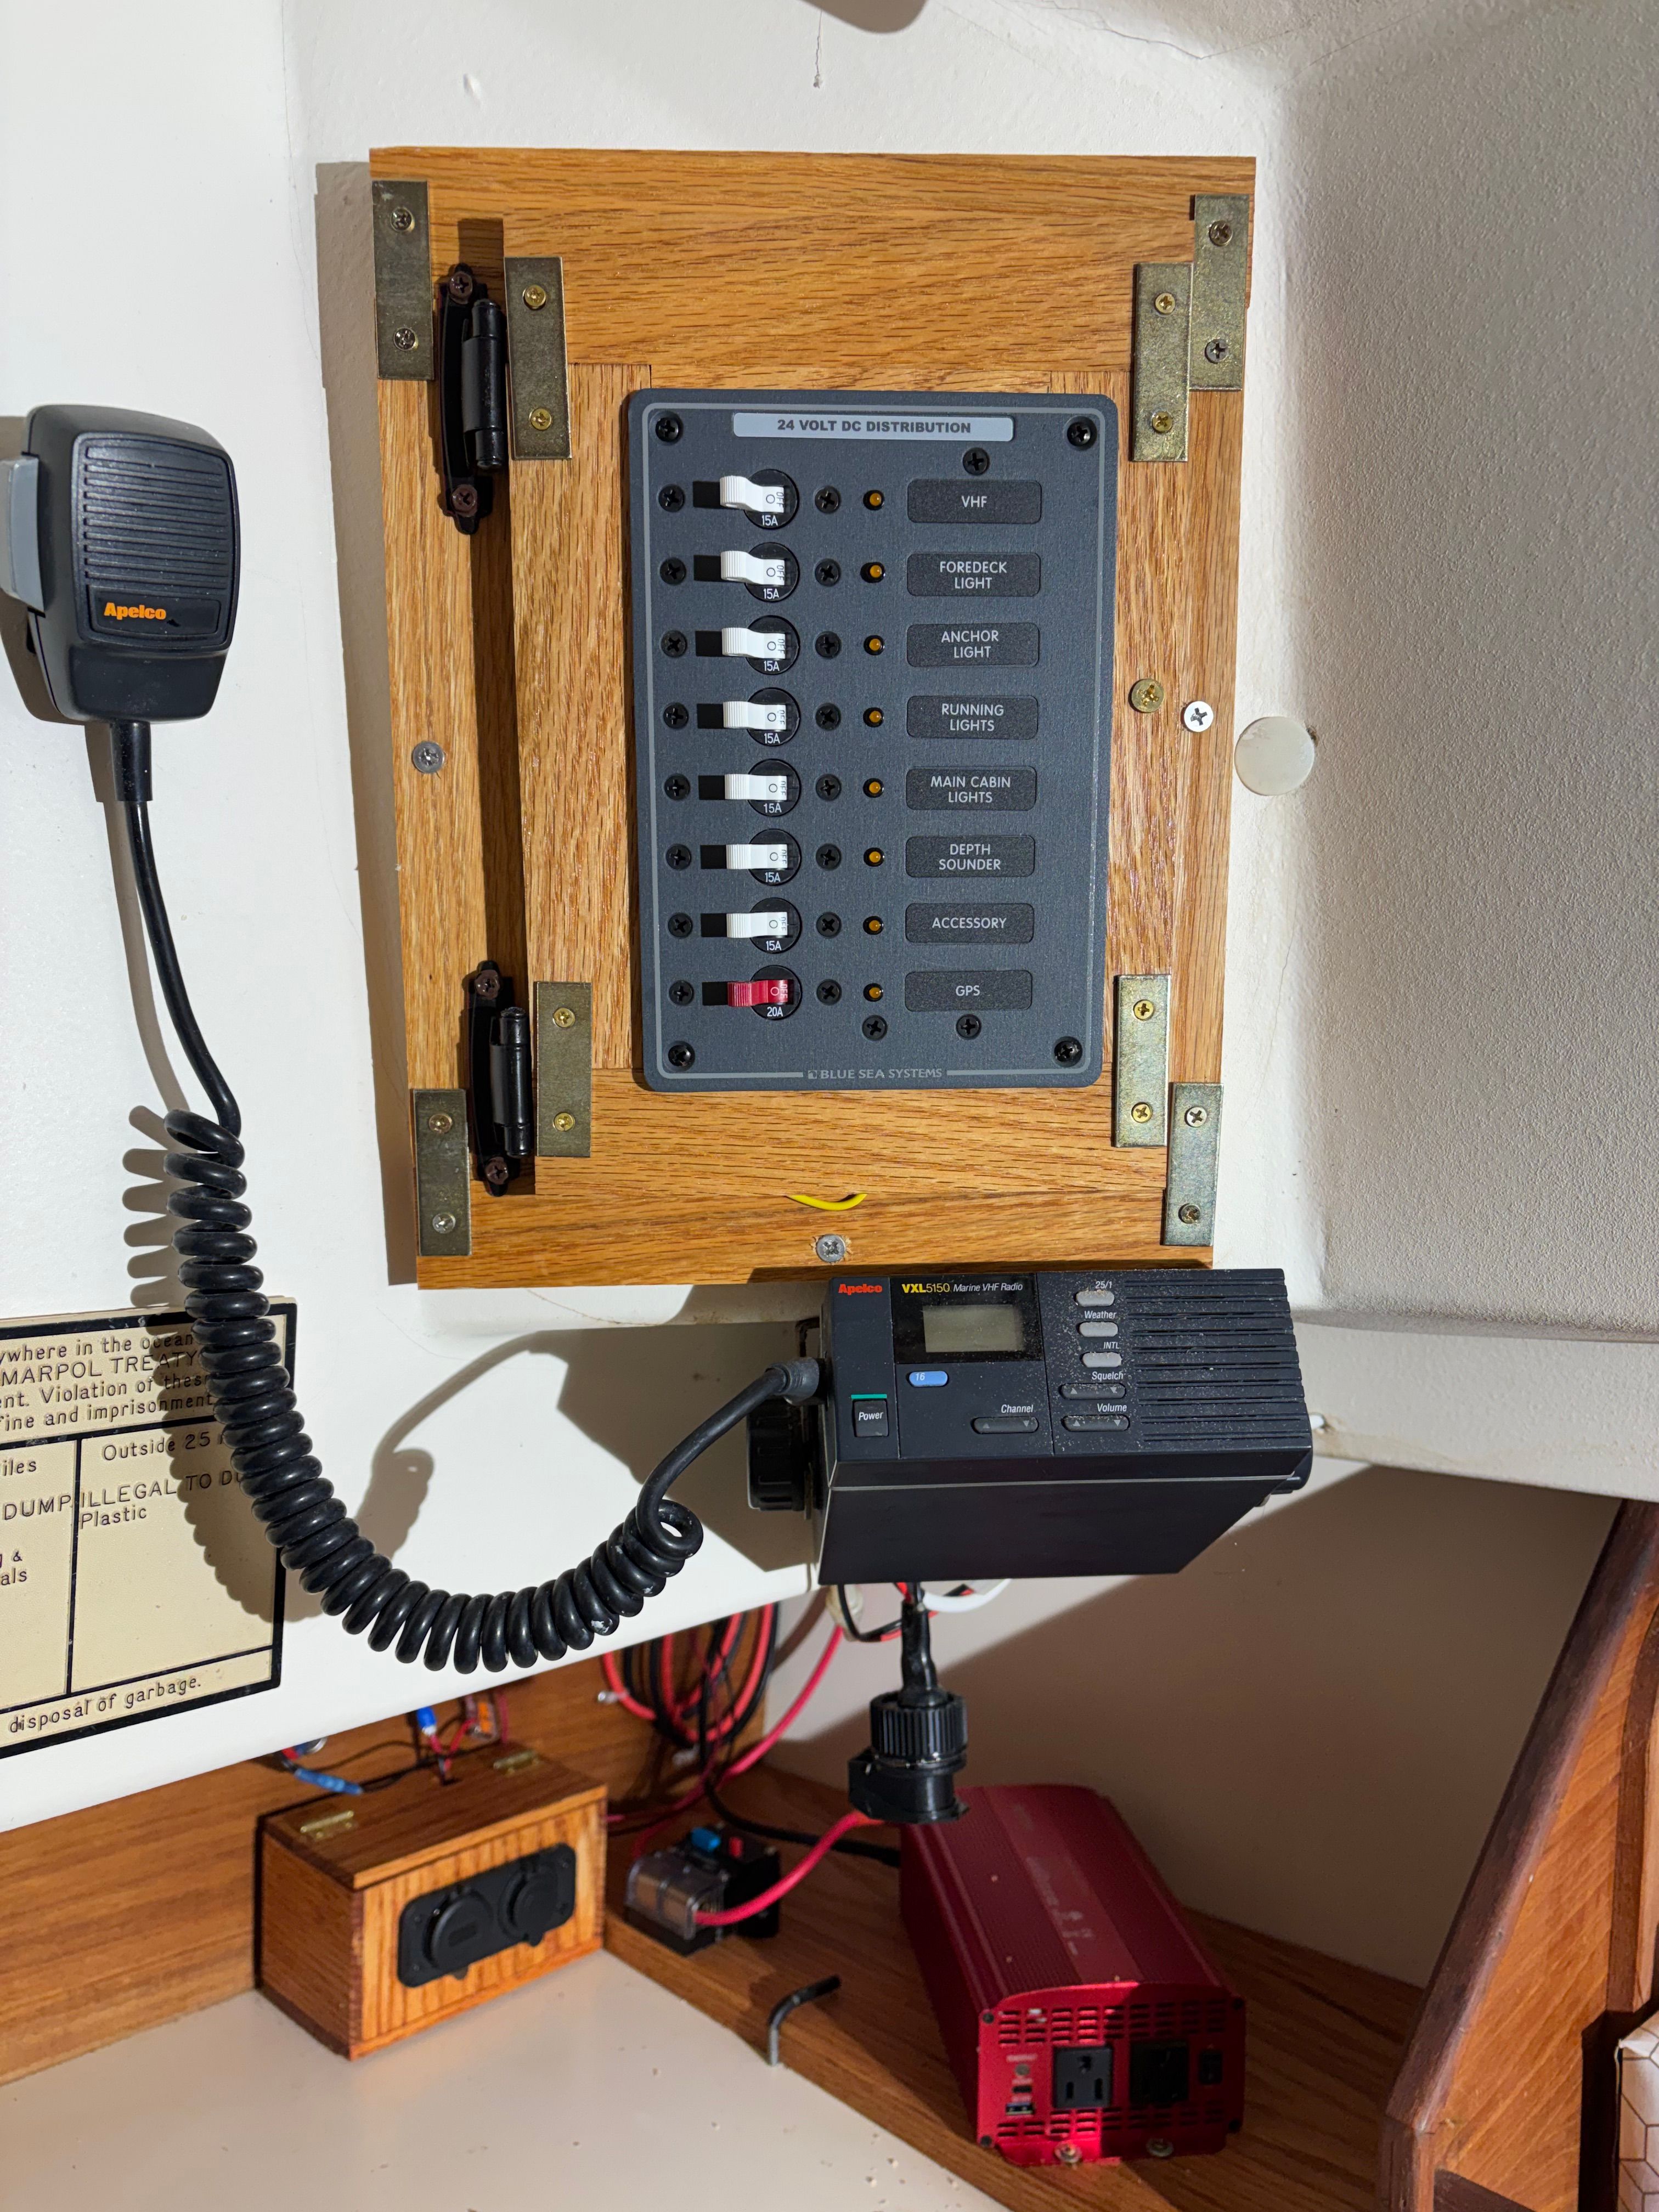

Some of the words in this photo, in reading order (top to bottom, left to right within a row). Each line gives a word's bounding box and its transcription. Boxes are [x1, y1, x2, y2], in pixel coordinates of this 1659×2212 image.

[777, 419, 795, 431] 24
[799, 420, 837, 431] VOLT
[842, 421, 861, 432] DC
[866, 421, 971, 433] DISTRIBUTION
[961, 495, 988, 508] VHF
[761, 515, 778, 526] 15A
[939, 561, 1007, 573] FOREDECK
[954, 577, 992, 589] LIGHT
[763, 588, 780, 599] 15A
[104, 602, 166, 620] Apelco
[941, 630, 999, 642] ANCHOR
[953, 646, 991, 658] LIGHT
[763, 661, 780, 672] 15A
[941, 703, 1005, 716] RUNNING
[950, 719, 995, 732] LIGHTS
[764, 733, 781, 744] 15A
[930, 776, 966, 788] MAIN
[970, 776, 1011, 788] CABIN
[948, 791, 993, 803] LIGHTS
[763, 803, 782, 814] 15A
[949, 844, 991, 855] DEPTH
[939, 859, 1001, 871] SOUNDER
[764, 872, 781, 883] 15A
[932, 917, 1007, 929] ACCESSORY
[765, 941, 782, 951] 15A
[955, 985, 980, 997] GPS
[766, 1007, 783, 1017] 20A
[820, 1070, 855, 1080] BLUE
[859, 1069, 884, 1079] SEA
[888, 1068, 943, 1079] SYSTEMS
[838, 1284, 883, 1296] Apelco
[901, 1283, 950, 1294] VXL5150
[953, 1284, 980, 1293] Marine
[982, 1283, 999, 1292] VHF
[1000, 1283, 1023, 1291] Radio
[1094, 1280, 1113, 1290] 25/1
[1084, 1310, 1116, 1319] Weather
[76, 1339, 93, 1356] in
[102, 1334, 132, 1352] the
[142, 1333, 193, 1350] ocean
[1103, 1341, 1120, 1350] INTL
[1, 1360, 101, 1387] MARPOL
[110, 1350, 198, 1374] TREATY
[915, 1372, 926, 1381] 16
[1091, 1371, 1124, 1381] Squelch
[0, 1391, 30, 1409] nt.
[41, 1379, 127, 1403] Violation
[138, 1376, 154, 1392] of
[165, 1373, 208, 1390] thes
[46, 1405, 78, 1426] and
[87, 1393, 213, 1420] imprisonment
[1000, 1404, 1034, 1414] Channel
[1097, 1403, 1127, 1413] Volume
[858, 1410, 884, 1421] Power
[103, 1435, 175, 1461] Outside
[185, 1431, 210, 1449] 25
[81, 1479, 177, 1508] ILLEGAL
[185, 1473, 212, 1491] TO
[4, 1494, 71, 1520] DUMP
[80, 1506, 148, 1530] Plastic
[13, 1550, 22, 1562] &
[10, 1700, 89, 1734] disposal
[98, 1694, 117, 1712] of
[126, 1677, 201, 1709] garbage.
